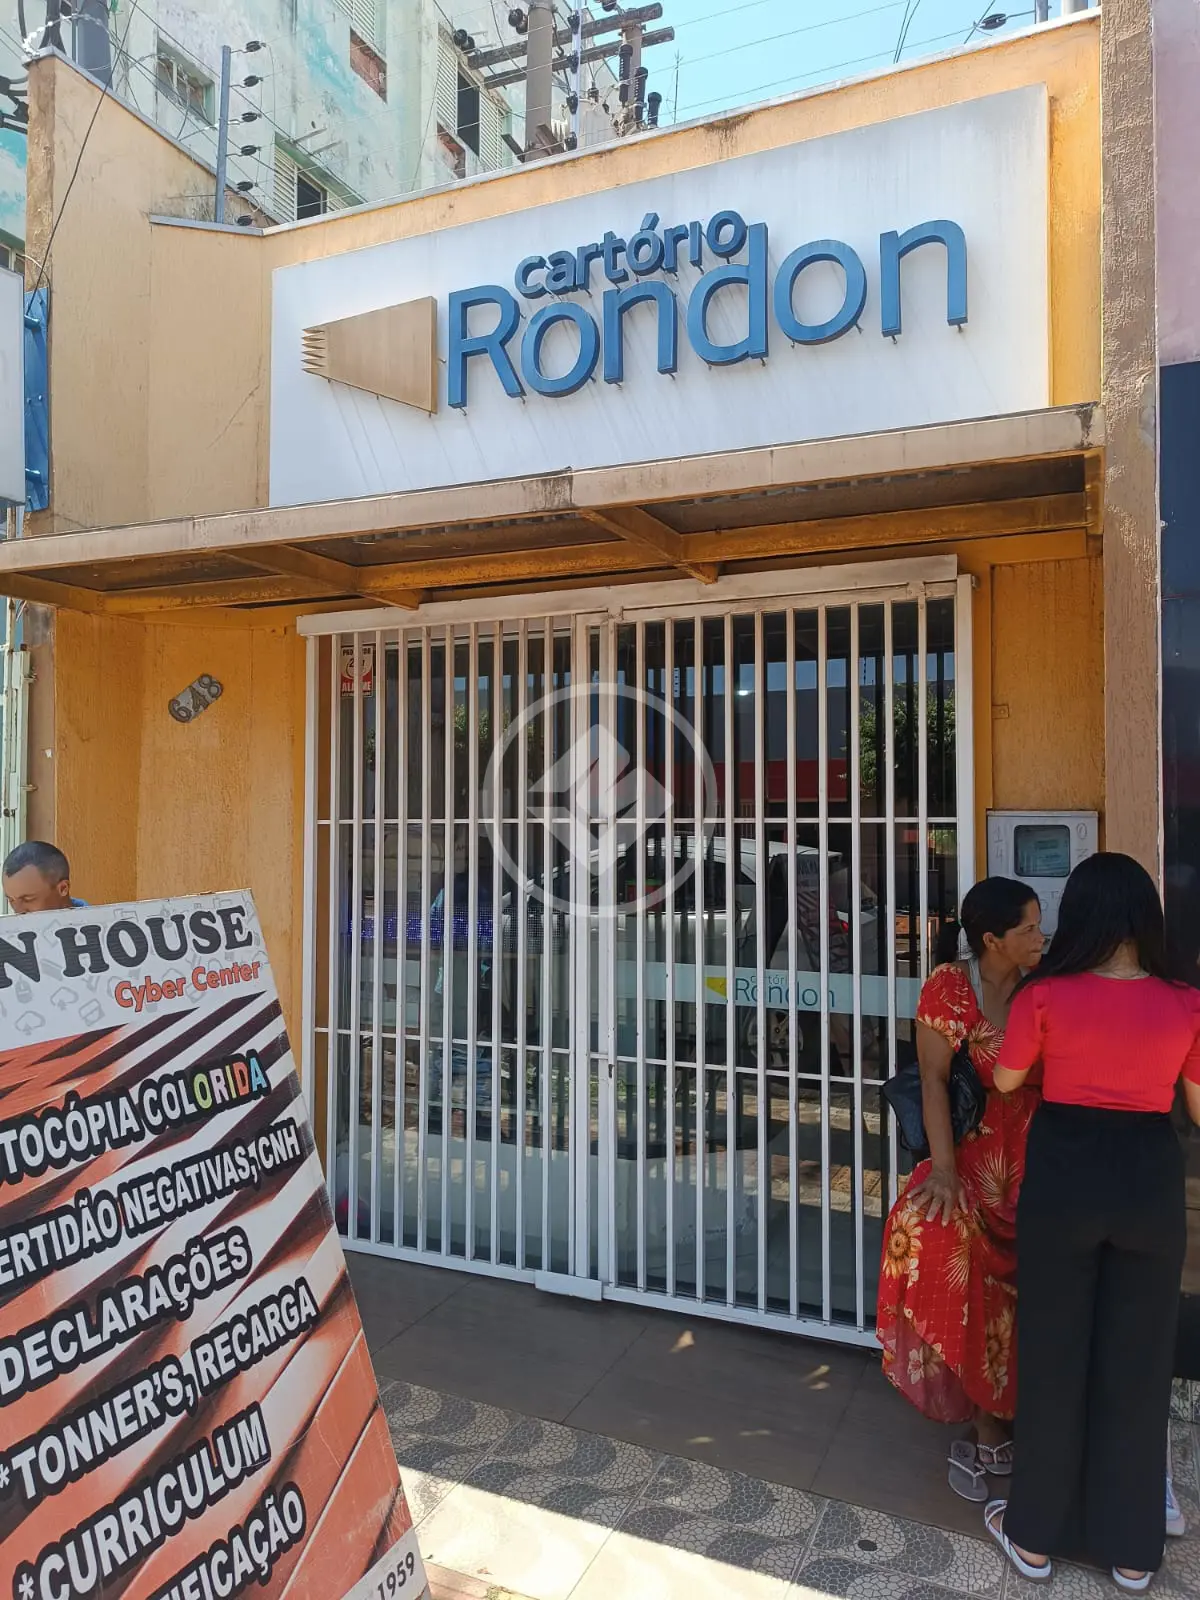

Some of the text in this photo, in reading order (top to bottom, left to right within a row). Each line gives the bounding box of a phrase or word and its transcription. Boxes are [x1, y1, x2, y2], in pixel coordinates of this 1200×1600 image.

[514, 210, 747, 299] cartório
[448, 219, 968, 408] Rondon
[168, 673, 224, 723] 648
[55, 905, 253, 978] HOUSE
[115, 961, 261, 1012] Cyber Center
[0, 1061, 268, 1174] TOCÓPIA COLORIDA
[0, 1197, 118, 1285] ERTIDÃO
[258, 1125, 301, 1169] CNH
[0, 1233, 249, 1396] DECLARAÇÕES
[195, 1284, 318, 1387] RECARGA
[160, 1490, 303, 1600] FICAÇÃO
[377, 1551, 414, 1600] 1959
